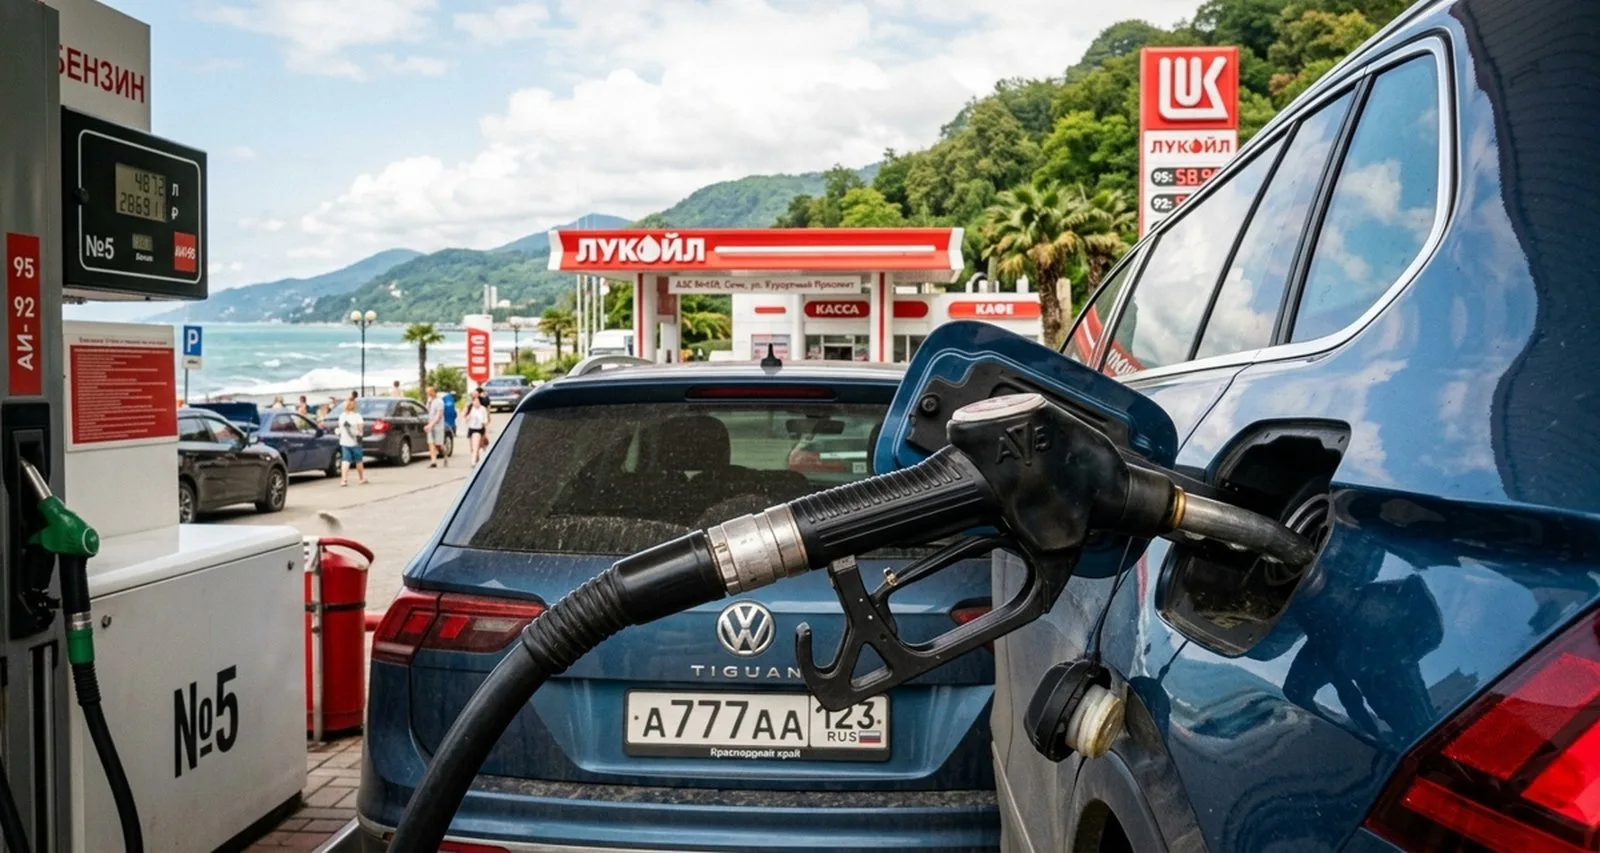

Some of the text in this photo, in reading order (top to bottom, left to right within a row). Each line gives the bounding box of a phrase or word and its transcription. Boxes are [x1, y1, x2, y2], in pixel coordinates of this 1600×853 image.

[1150, 136, 1231, 155] ЛУКОЙЛ
[172, 183, 179, 197] Л
[85, 234, 115, 260] №5
[574, 232, 706, 264] ЛУКОЙЛ
[13, 256, 34, 279] 95
[14, 295, 35, 318] 92
[815, 303, 860, 316] КАССА
[974, 303, 1015, 316] КАФЕ
[690, 664, 801, 679] TIGUAN
[174, 663, 239, 779] №5
[827, 731, 858, 743] RUS
